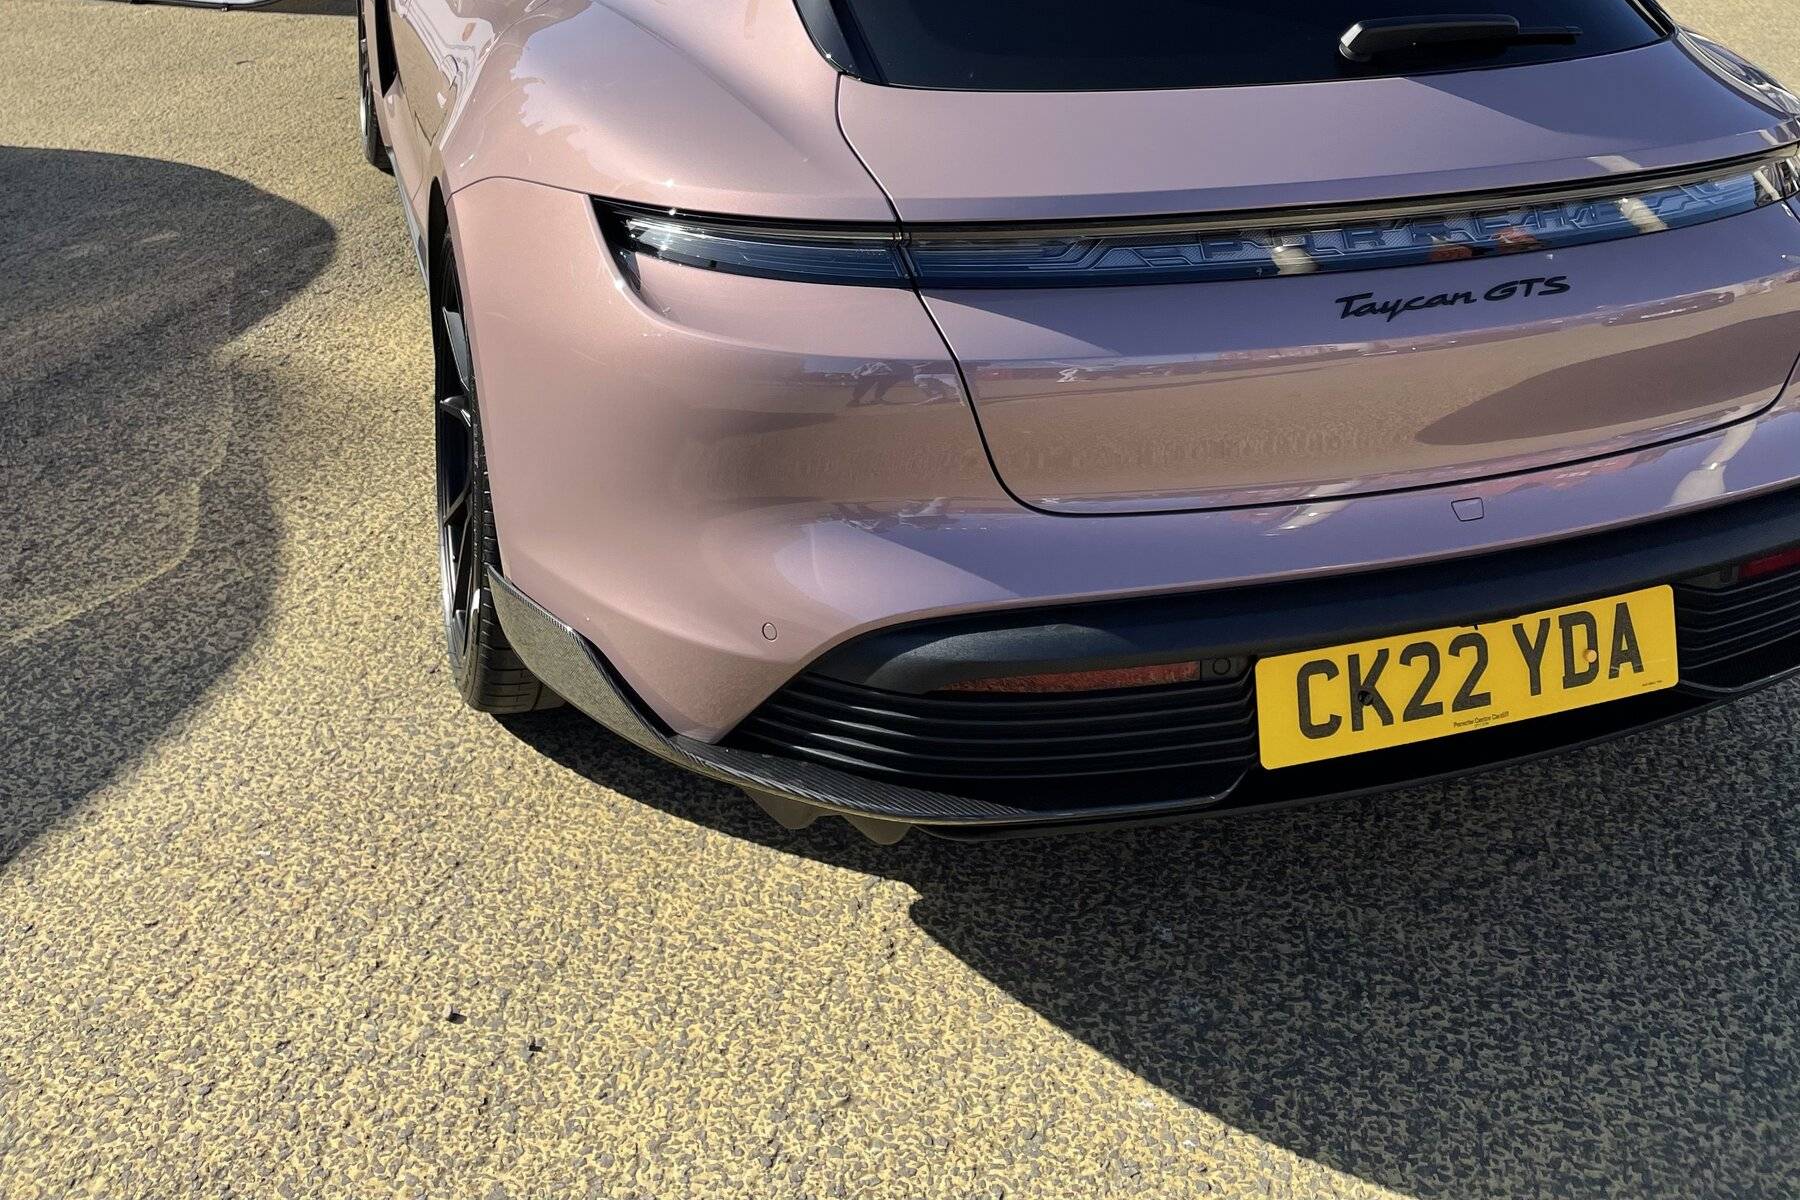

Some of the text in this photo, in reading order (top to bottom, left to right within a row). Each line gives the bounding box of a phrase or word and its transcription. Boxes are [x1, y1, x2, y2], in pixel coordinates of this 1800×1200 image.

[1334, 275, 1571, 322] Taycan GTS
[1296, 602, 1645, 740] CK22 YDA
